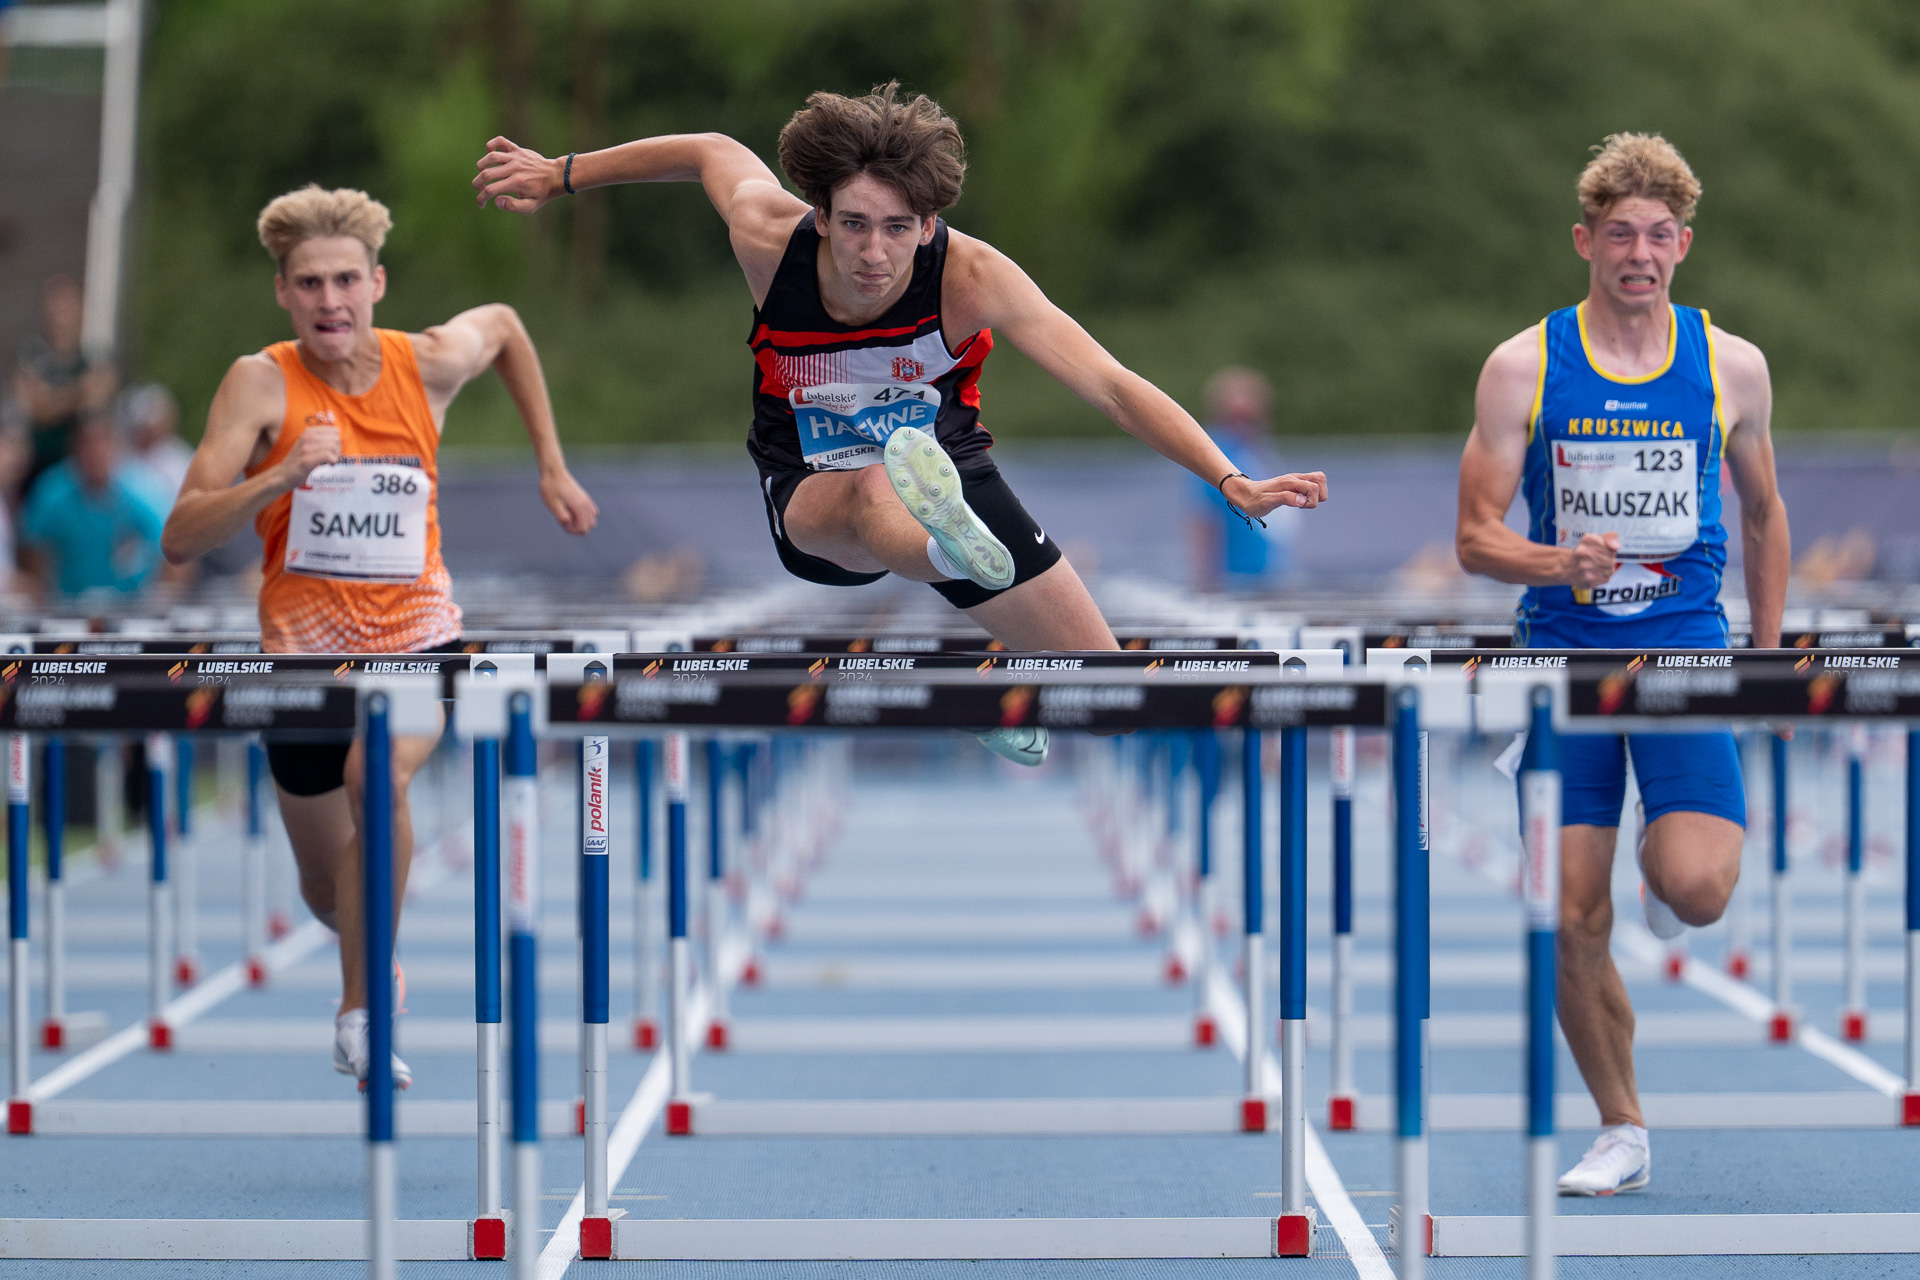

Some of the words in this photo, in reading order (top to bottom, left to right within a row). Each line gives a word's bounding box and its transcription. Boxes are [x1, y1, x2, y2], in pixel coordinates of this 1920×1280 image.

[806, 391, 857, 403] lubelskie
[873, 387, 925, 402] 471
[1568, 418, 1684, 438] KRUSZWICA
[826, 446, 876, 462] LUBELSKIE
[1634, 449, 1683, 472] 123
[371, 474, 418, 495] 386
[1561, 488, 1689, 517] PALUSZAK
[309, 512, 405, 538] SAMUL
[30, 661, 107, 674] LUBELSKIE
[197, 661, 274, 674] LUBELSKIE
[363, 662, 441, 674] LUBELSKIE
[672, 660, 750, 672] LUBELSKIE
[838, 658, 916, 670] LUBELSKIE
[1006, 659, 1084, 671] LUBELSKIE
[1173, 660, 1250, 672] LUBELSKIE
[1490, 656, 1568, 669] LUBELSKIE
[1656, 656, 1734, 668] LUBELSKIE
[1823, 656, 1901, 668] LUBELSKIE
[31, 675, 66, 687] 2024
[197, 675, 232, 687] 2024
[838, 672, 873, 684] 2024
[587, 765, 605, 833] polanik
